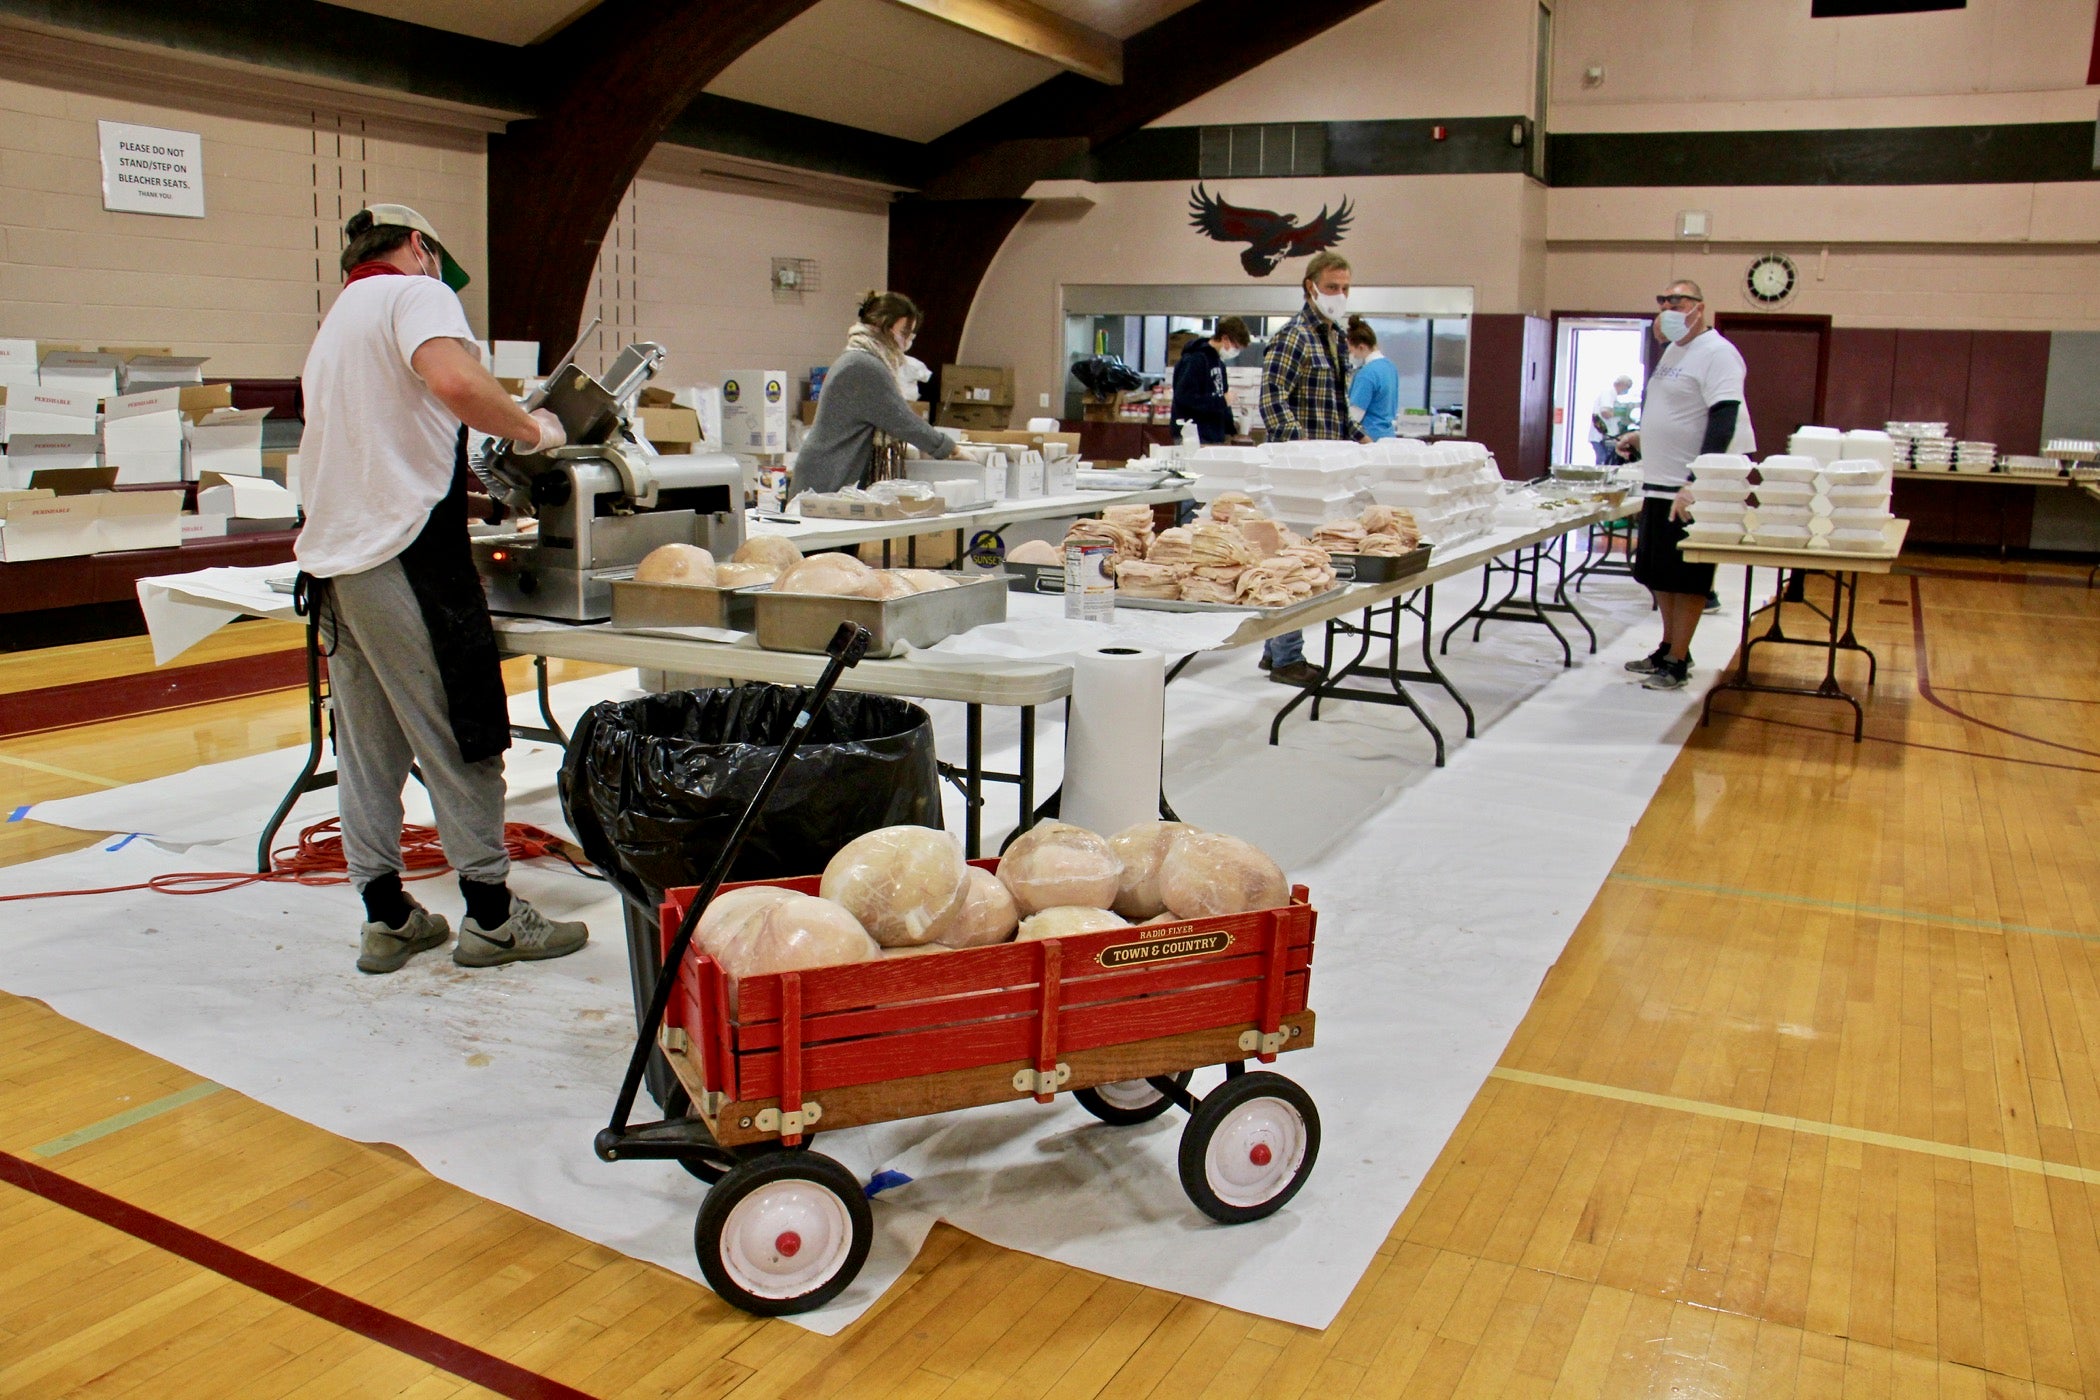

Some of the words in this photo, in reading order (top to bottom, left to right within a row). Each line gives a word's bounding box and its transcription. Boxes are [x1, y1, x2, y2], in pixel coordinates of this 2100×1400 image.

[119, 141, 150, 153] PLEASE
[152, 146, 165, 155] DO
[167, 148, 184, 157] NOT
[119, 158, 172, 171] STAND/STEP
[174, 164, 187, 173] ON
[118, 174, 161, 186] BLEACHER
[163, 179, 190, 189] SEATS.
[138, 190, 158, 198] THANK
[1140, 928, 1166, 940] RADIO
[1168, 925, 1194, 936] FLYER
[1113, 946, 1149, 961] TOWN
[1151, 945, 1160, 956] &
[1162, 937, 1218, 955] COUNTRY
